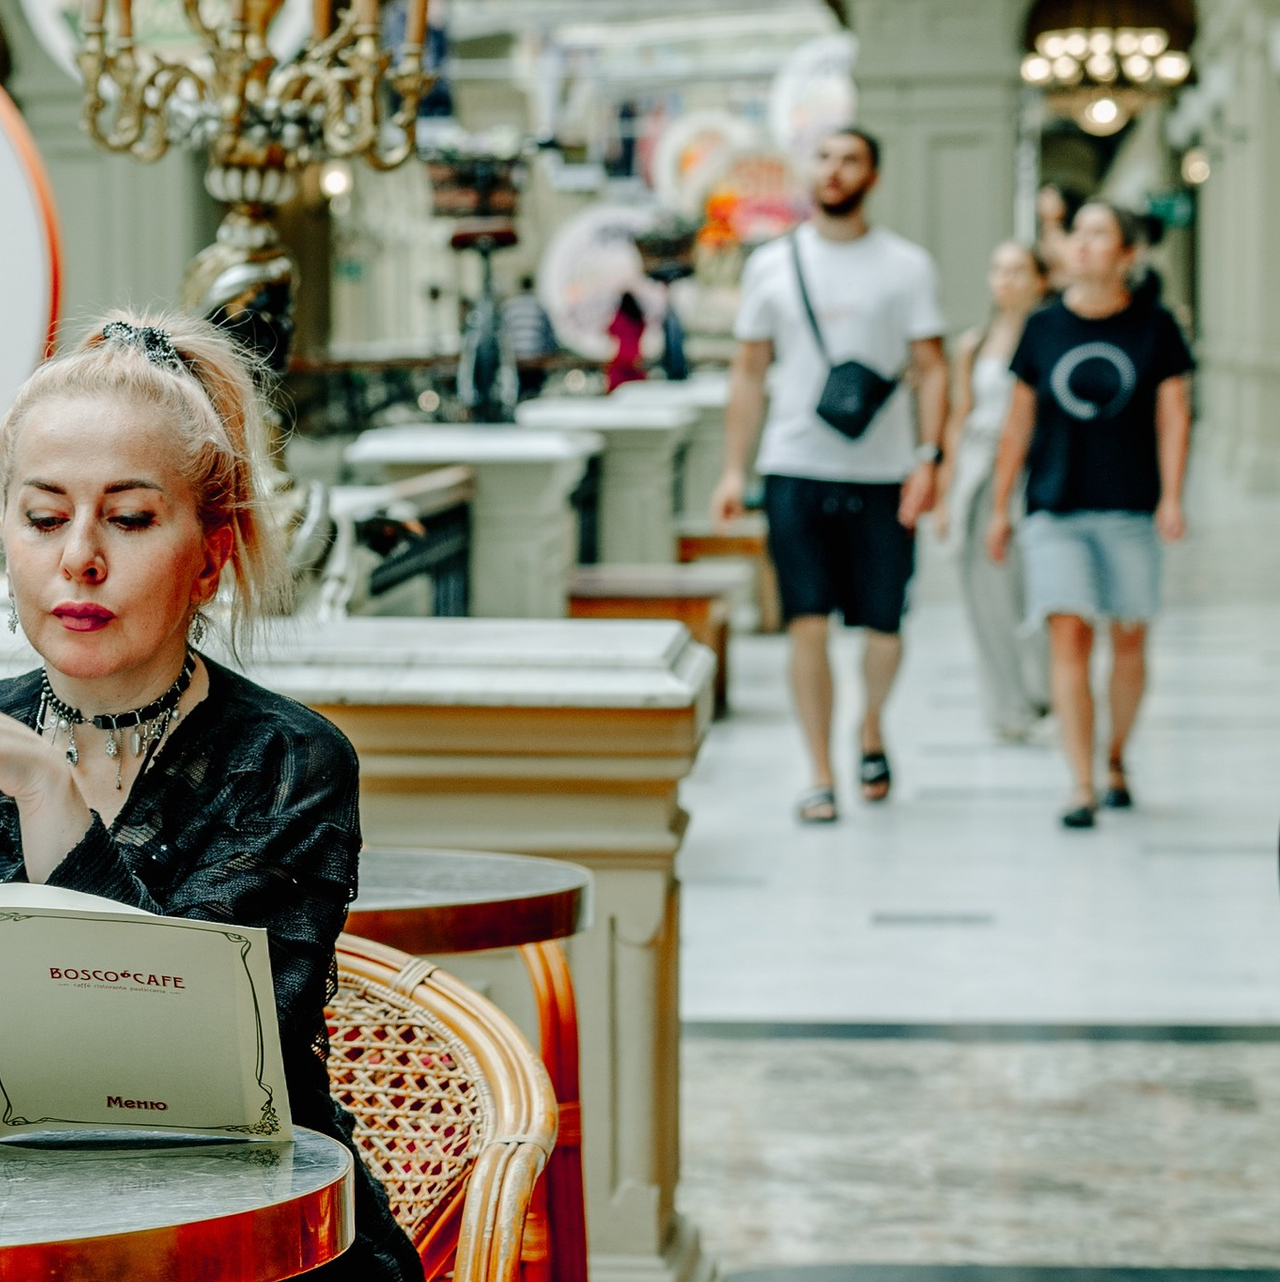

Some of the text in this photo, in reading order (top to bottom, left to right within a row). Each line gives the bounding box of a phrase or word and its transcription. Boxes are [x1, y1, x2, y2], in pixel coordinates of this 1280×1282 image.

[49, 967, 186, 989] BOSCO CAFE
[106, 1096, 168, 1111] Меню
